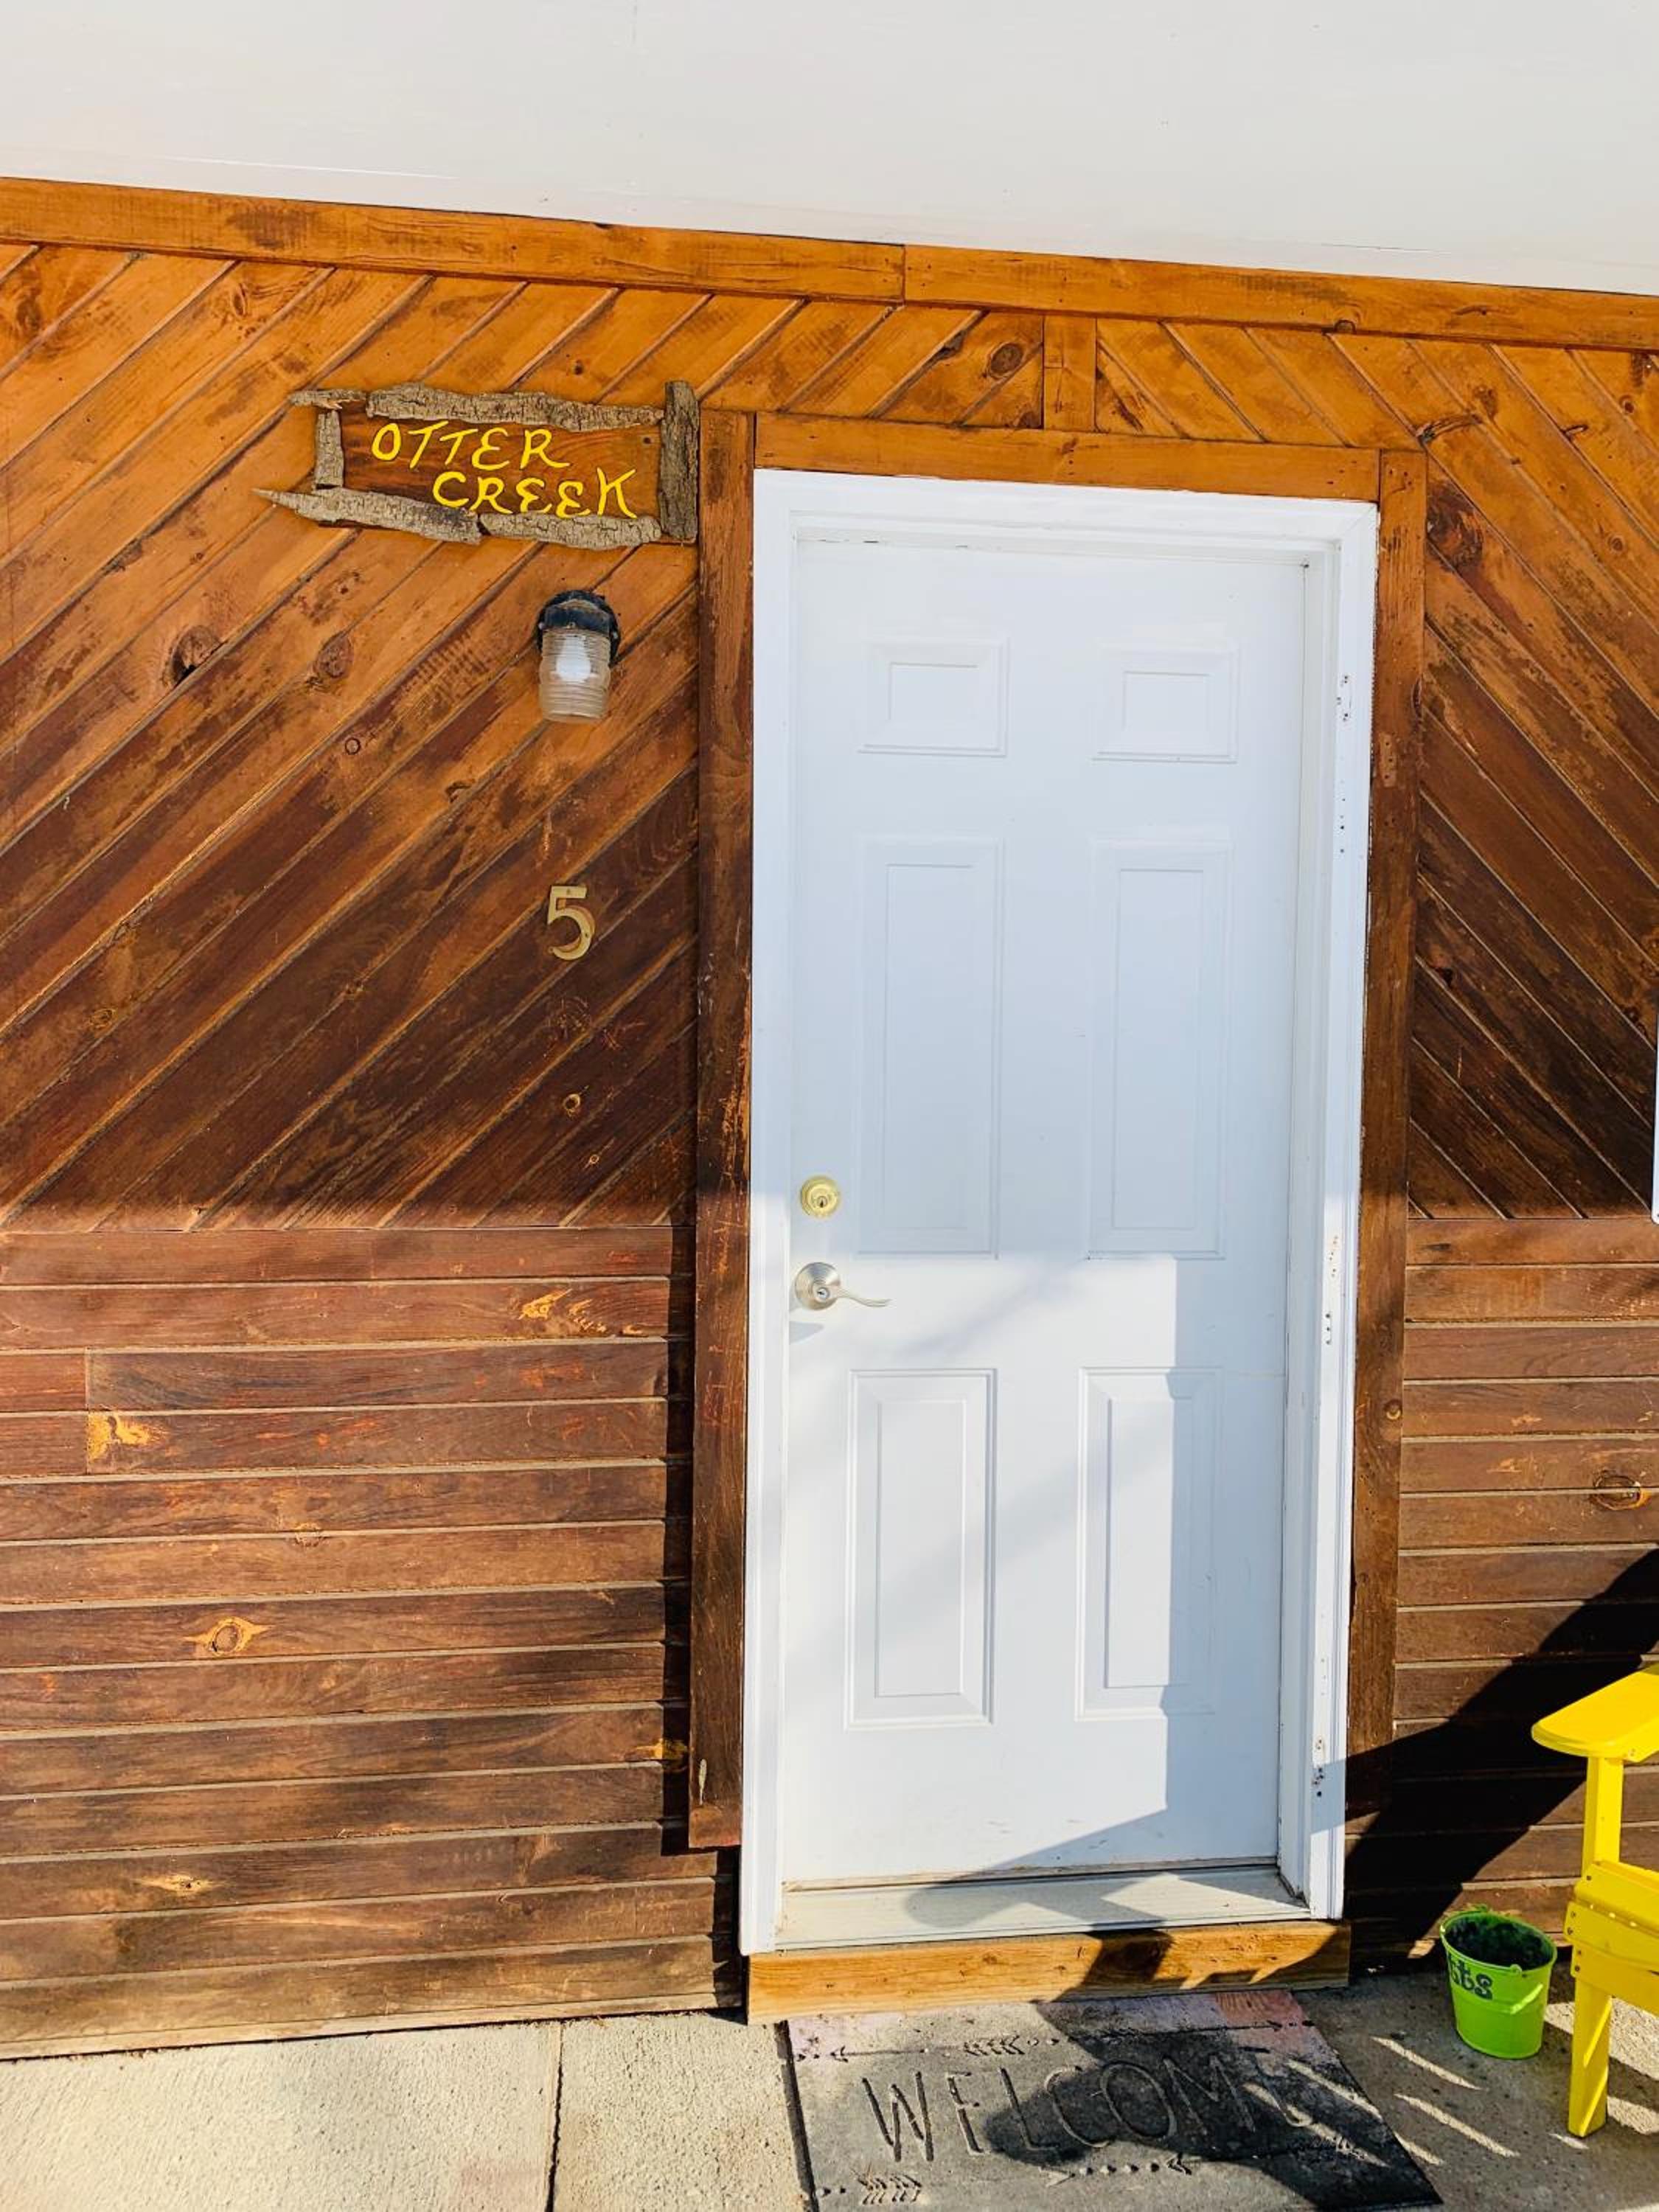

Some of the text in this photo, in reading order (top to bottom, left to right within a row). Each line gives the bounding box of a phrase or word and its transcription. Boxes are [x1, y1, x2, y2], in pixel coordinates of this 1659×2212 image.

[371, 420, 570, 470] OTTER
[432, 467, 638, 518] CREEK
[547, 885, 593, 961] 5
